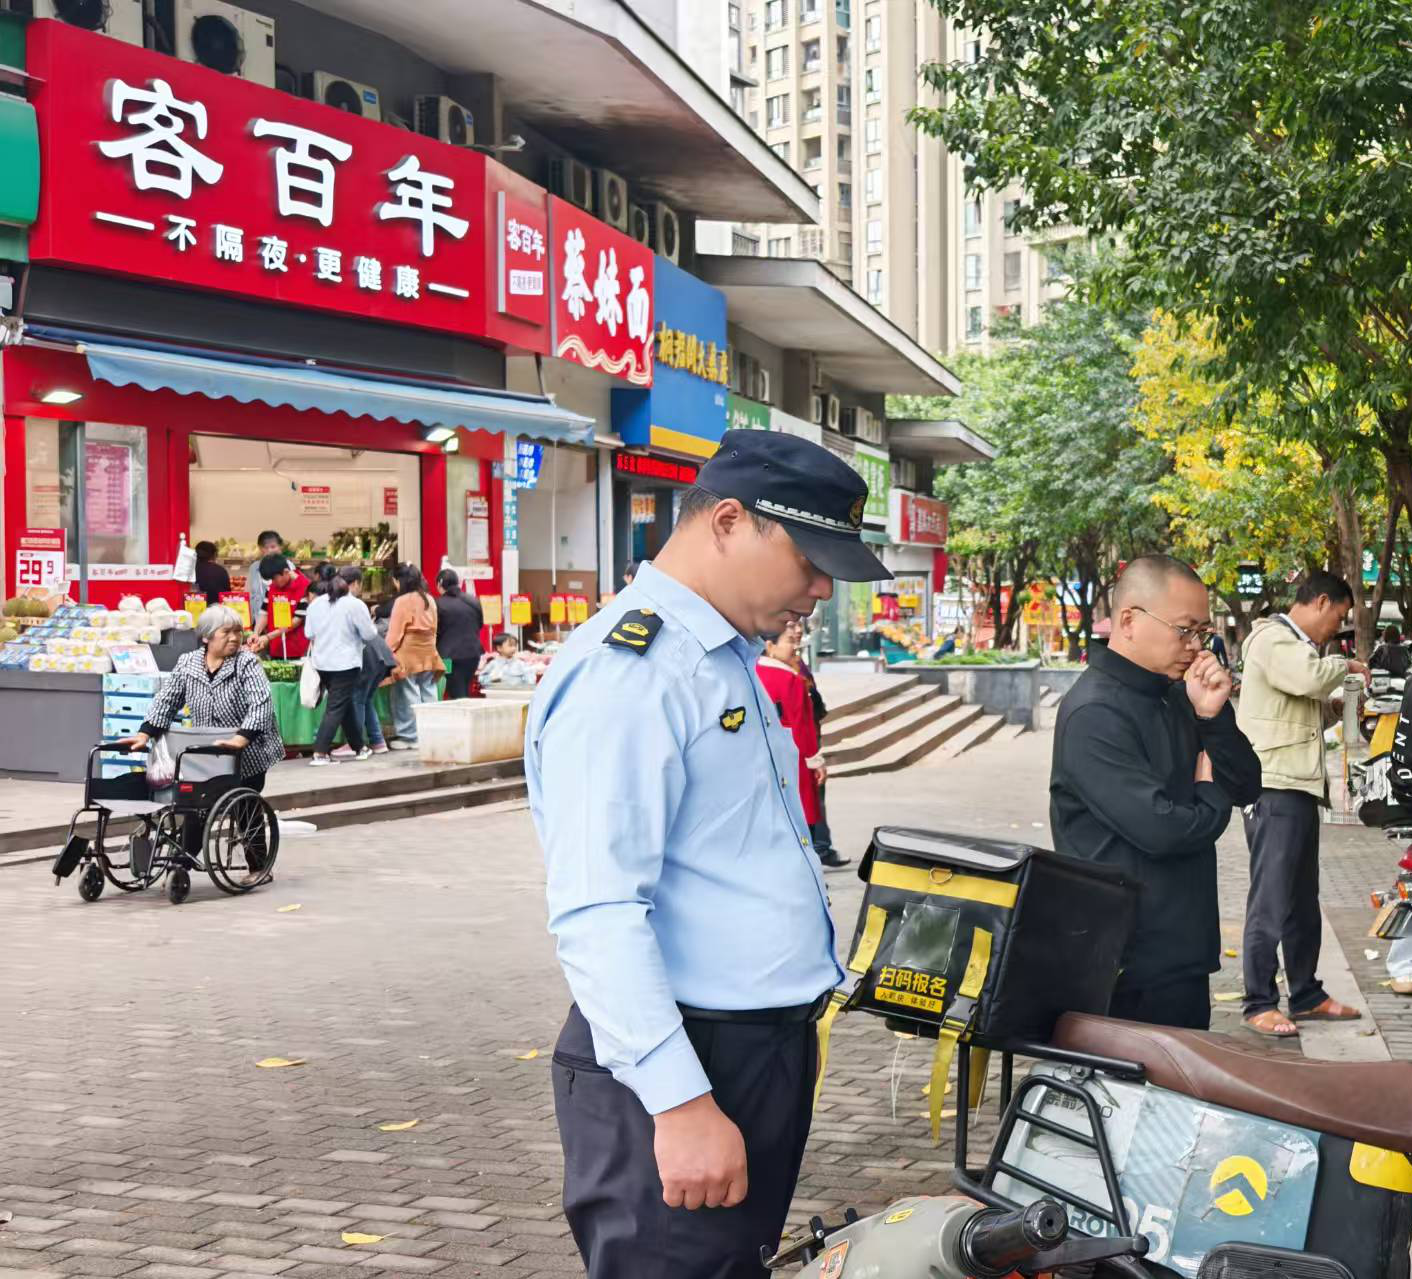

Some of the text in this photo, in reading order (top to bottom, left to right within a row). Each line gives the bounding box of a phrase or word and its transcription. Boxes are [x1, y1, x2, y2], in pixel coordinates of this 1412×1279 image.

[94, 78, 470, 257] 客百年
[507, 218, 545, 261] 客百年
[19, 559, 42, 585] 29
[1392, 712, 1412, 797] DENT
[879, 965, 948, 998] 扫码报名
